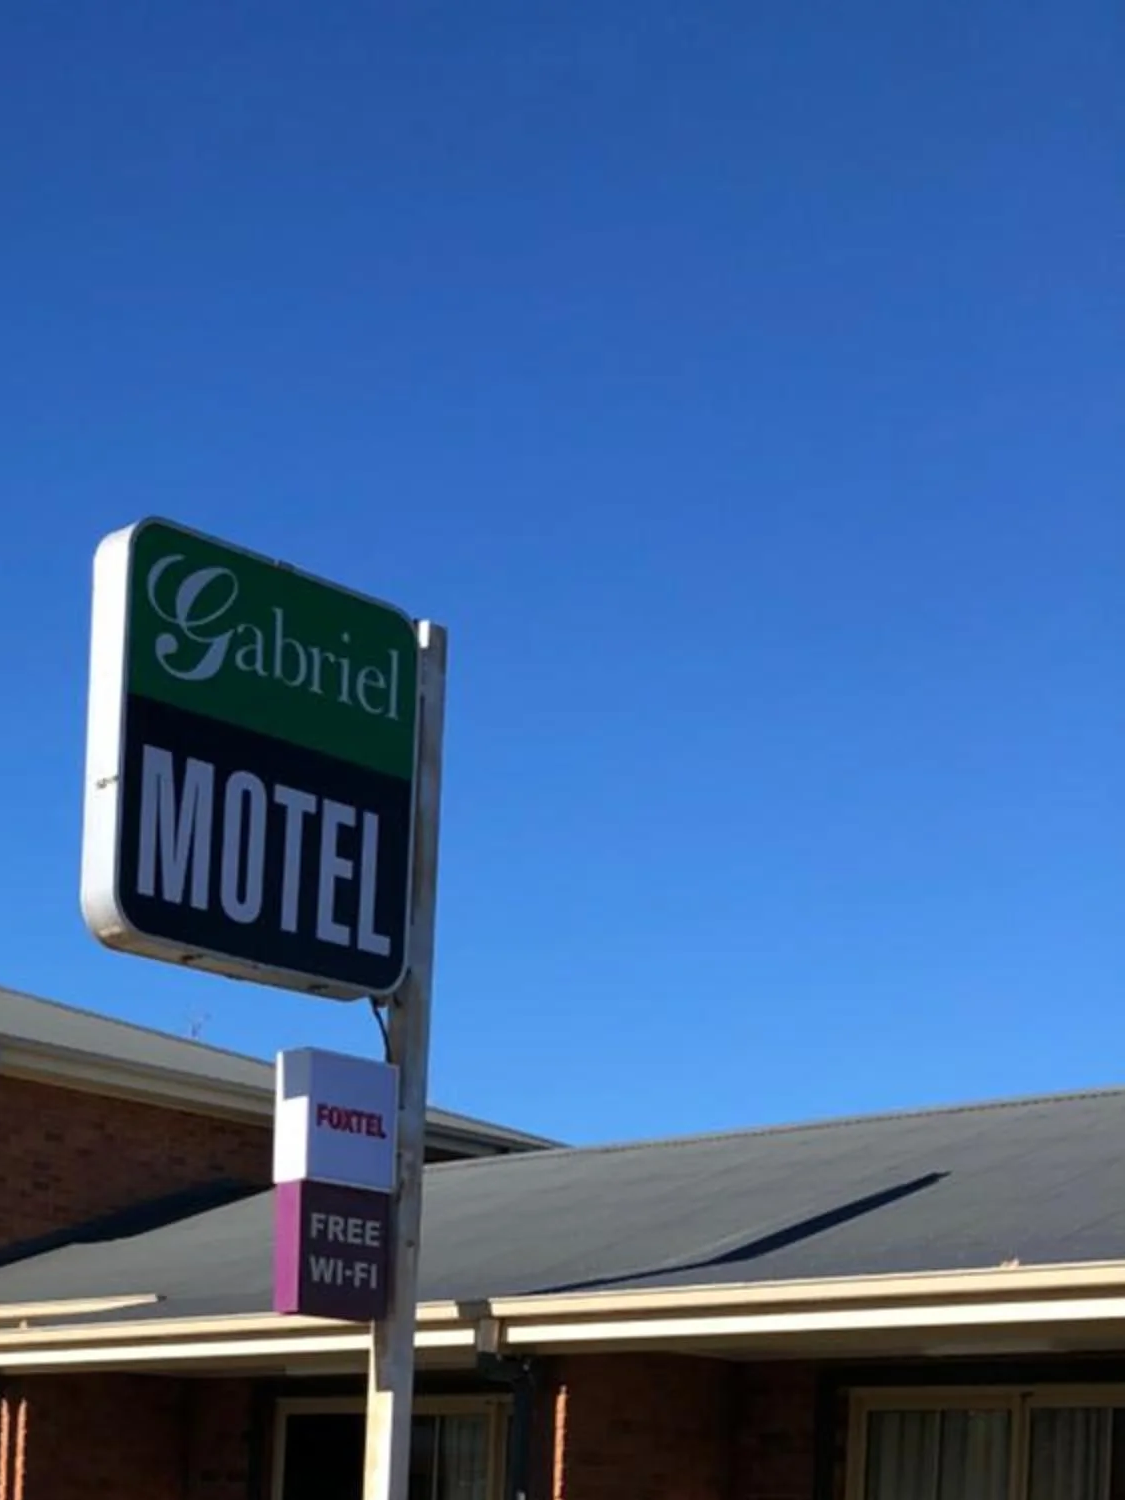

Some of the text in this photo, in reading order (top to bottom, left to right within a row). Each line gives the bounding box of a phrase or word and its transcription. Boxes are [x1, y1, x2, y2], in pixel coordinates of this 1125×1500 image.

[147, 553, 400, 721] Gabriel
[136, 743, 392, 957] MOTEL
[315, 1103, 387, 1140] FOXTEL
[309, 1212, 382, 1247] FREE
[309, 1255, 378, 1289] WI-FI
